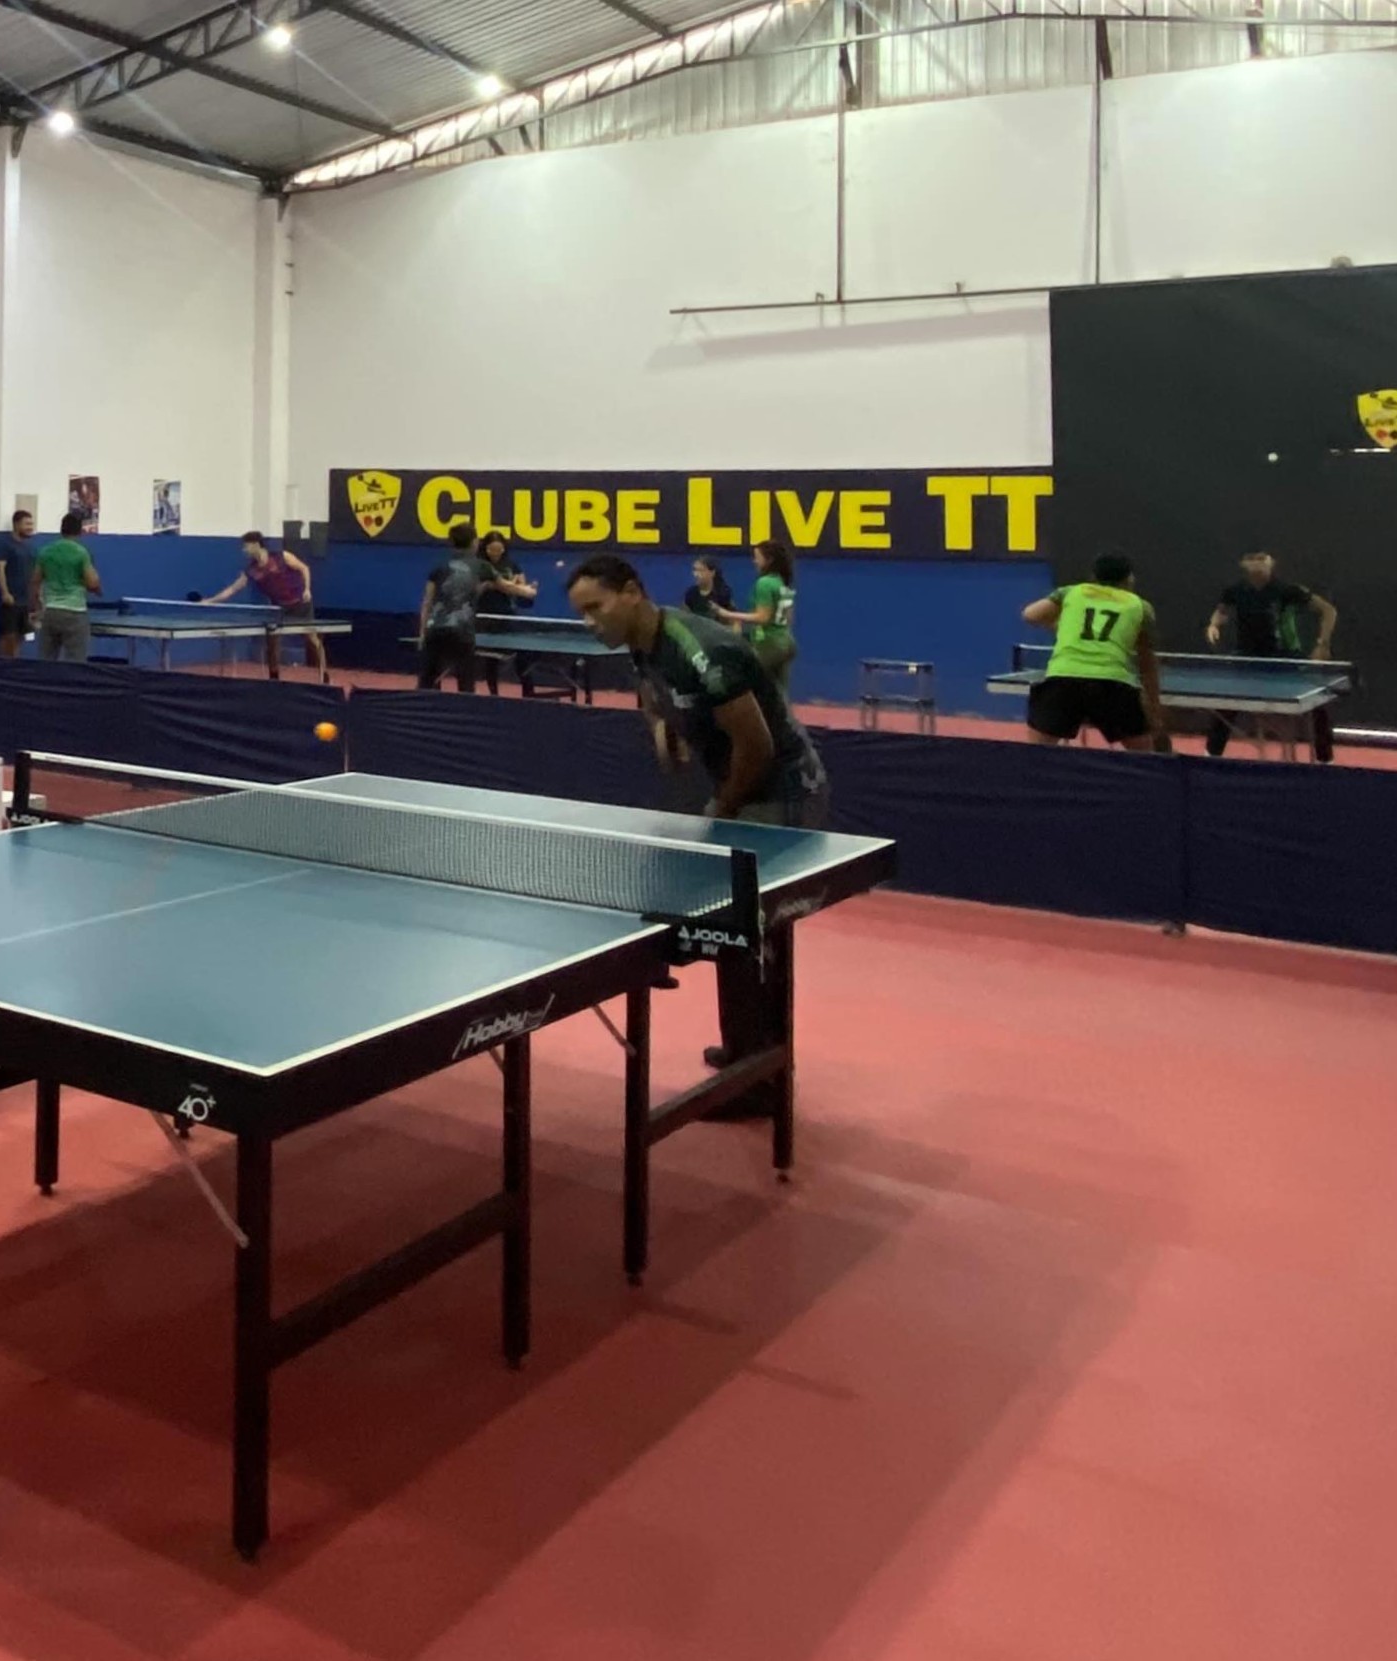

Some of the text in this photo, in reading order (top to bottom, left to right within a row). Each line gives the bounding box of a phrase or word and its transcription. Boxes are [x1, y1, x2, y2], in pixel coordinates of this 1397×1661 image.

[417, 475, 1054, 551] CLUBE LIVE TT
[1080, 607, 1121, 642] 17
[691, 926, 749, 948] JOOLA
[463, 1010, 529, 1050] Hobby
